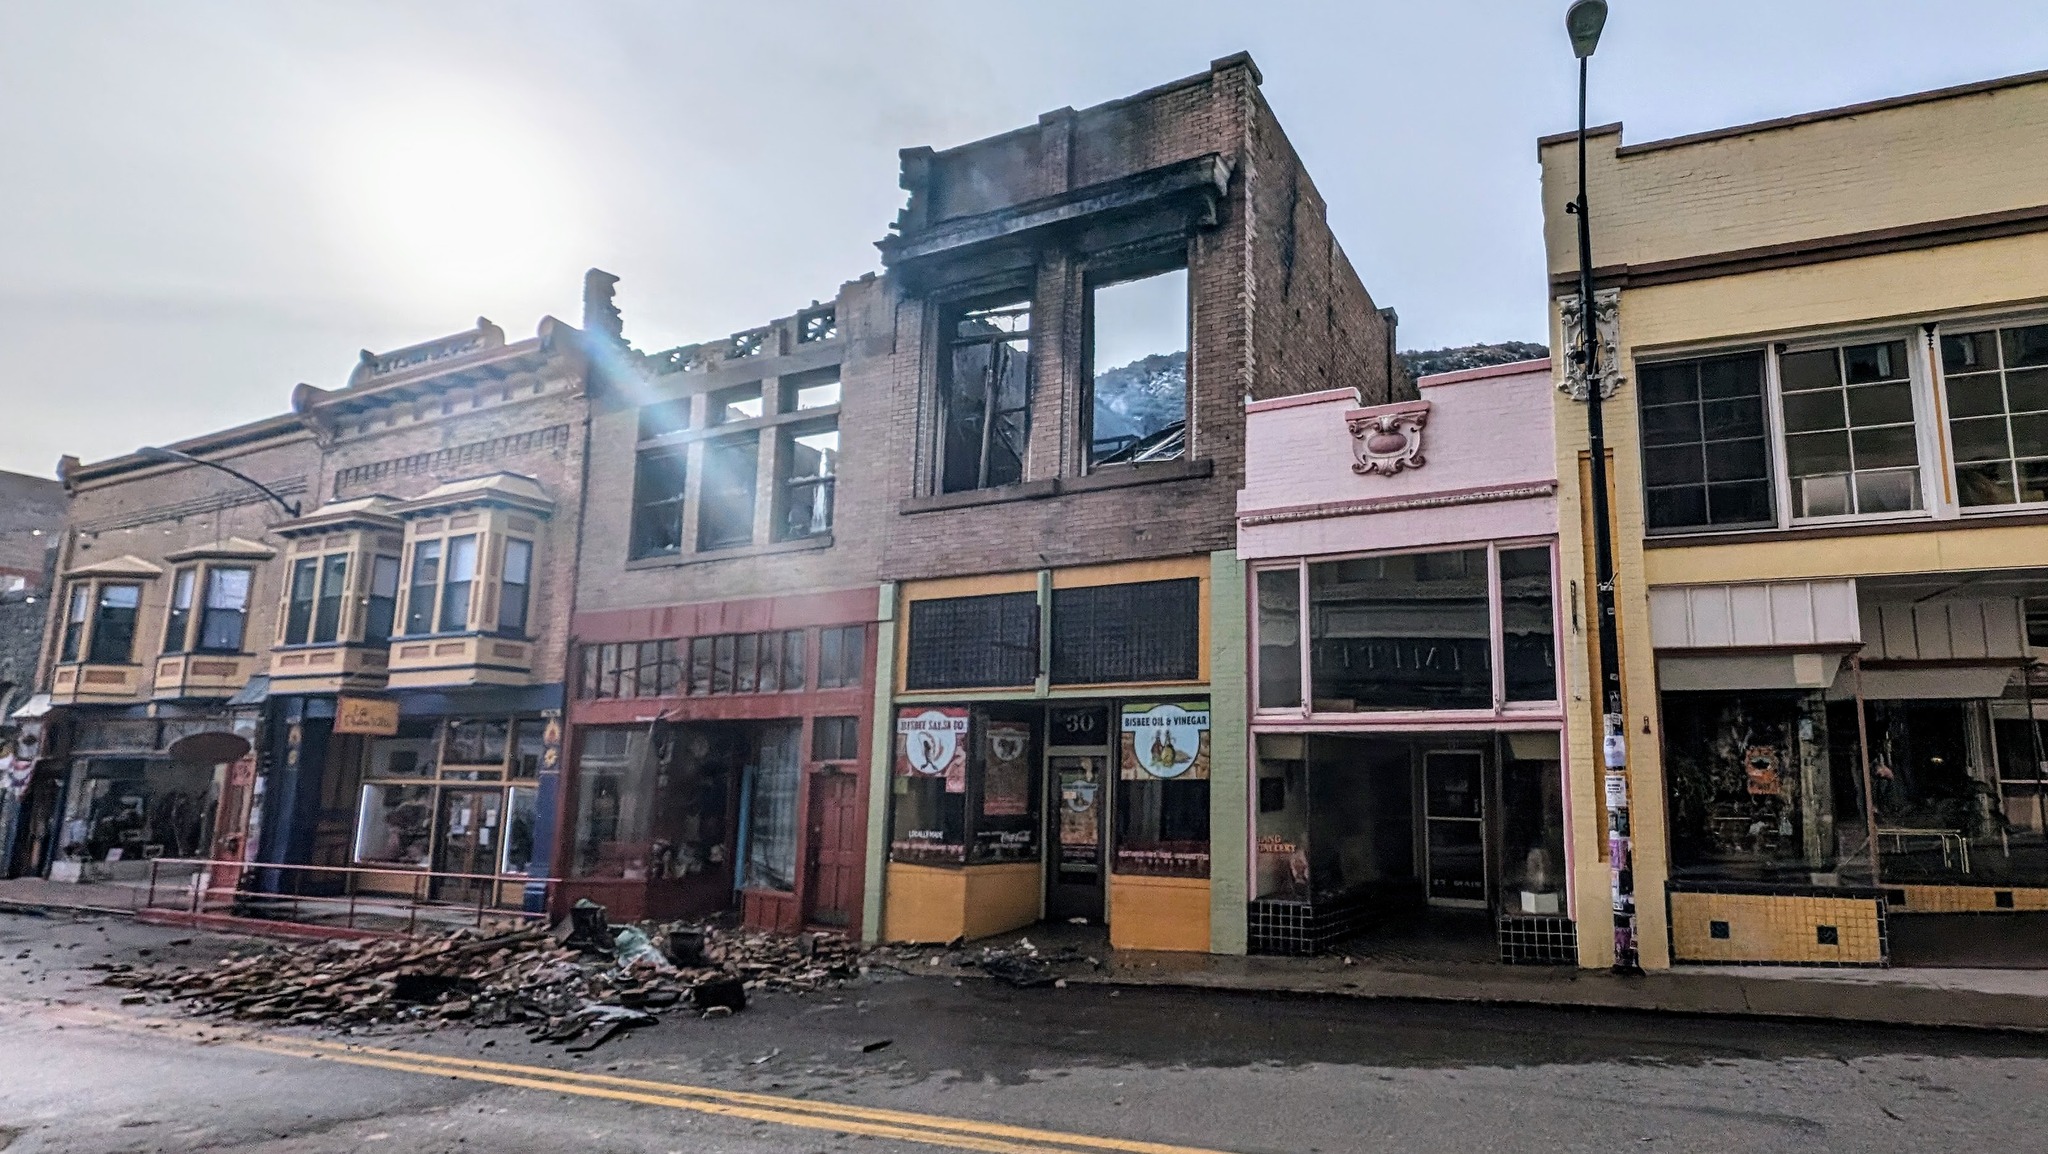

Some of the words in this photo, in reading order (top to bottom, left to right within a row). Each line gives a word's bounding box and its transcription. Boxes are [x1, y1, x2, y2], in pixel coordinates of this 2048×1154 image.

[1066, 714, 1094, 732] 30
[1124, 716, 1150, 727] BISBEE
[1152, 716, 1164, 726] OIL
[1165, 717, 1171, 726] &
[1173, 715, 1207, 726] VINEGAR
